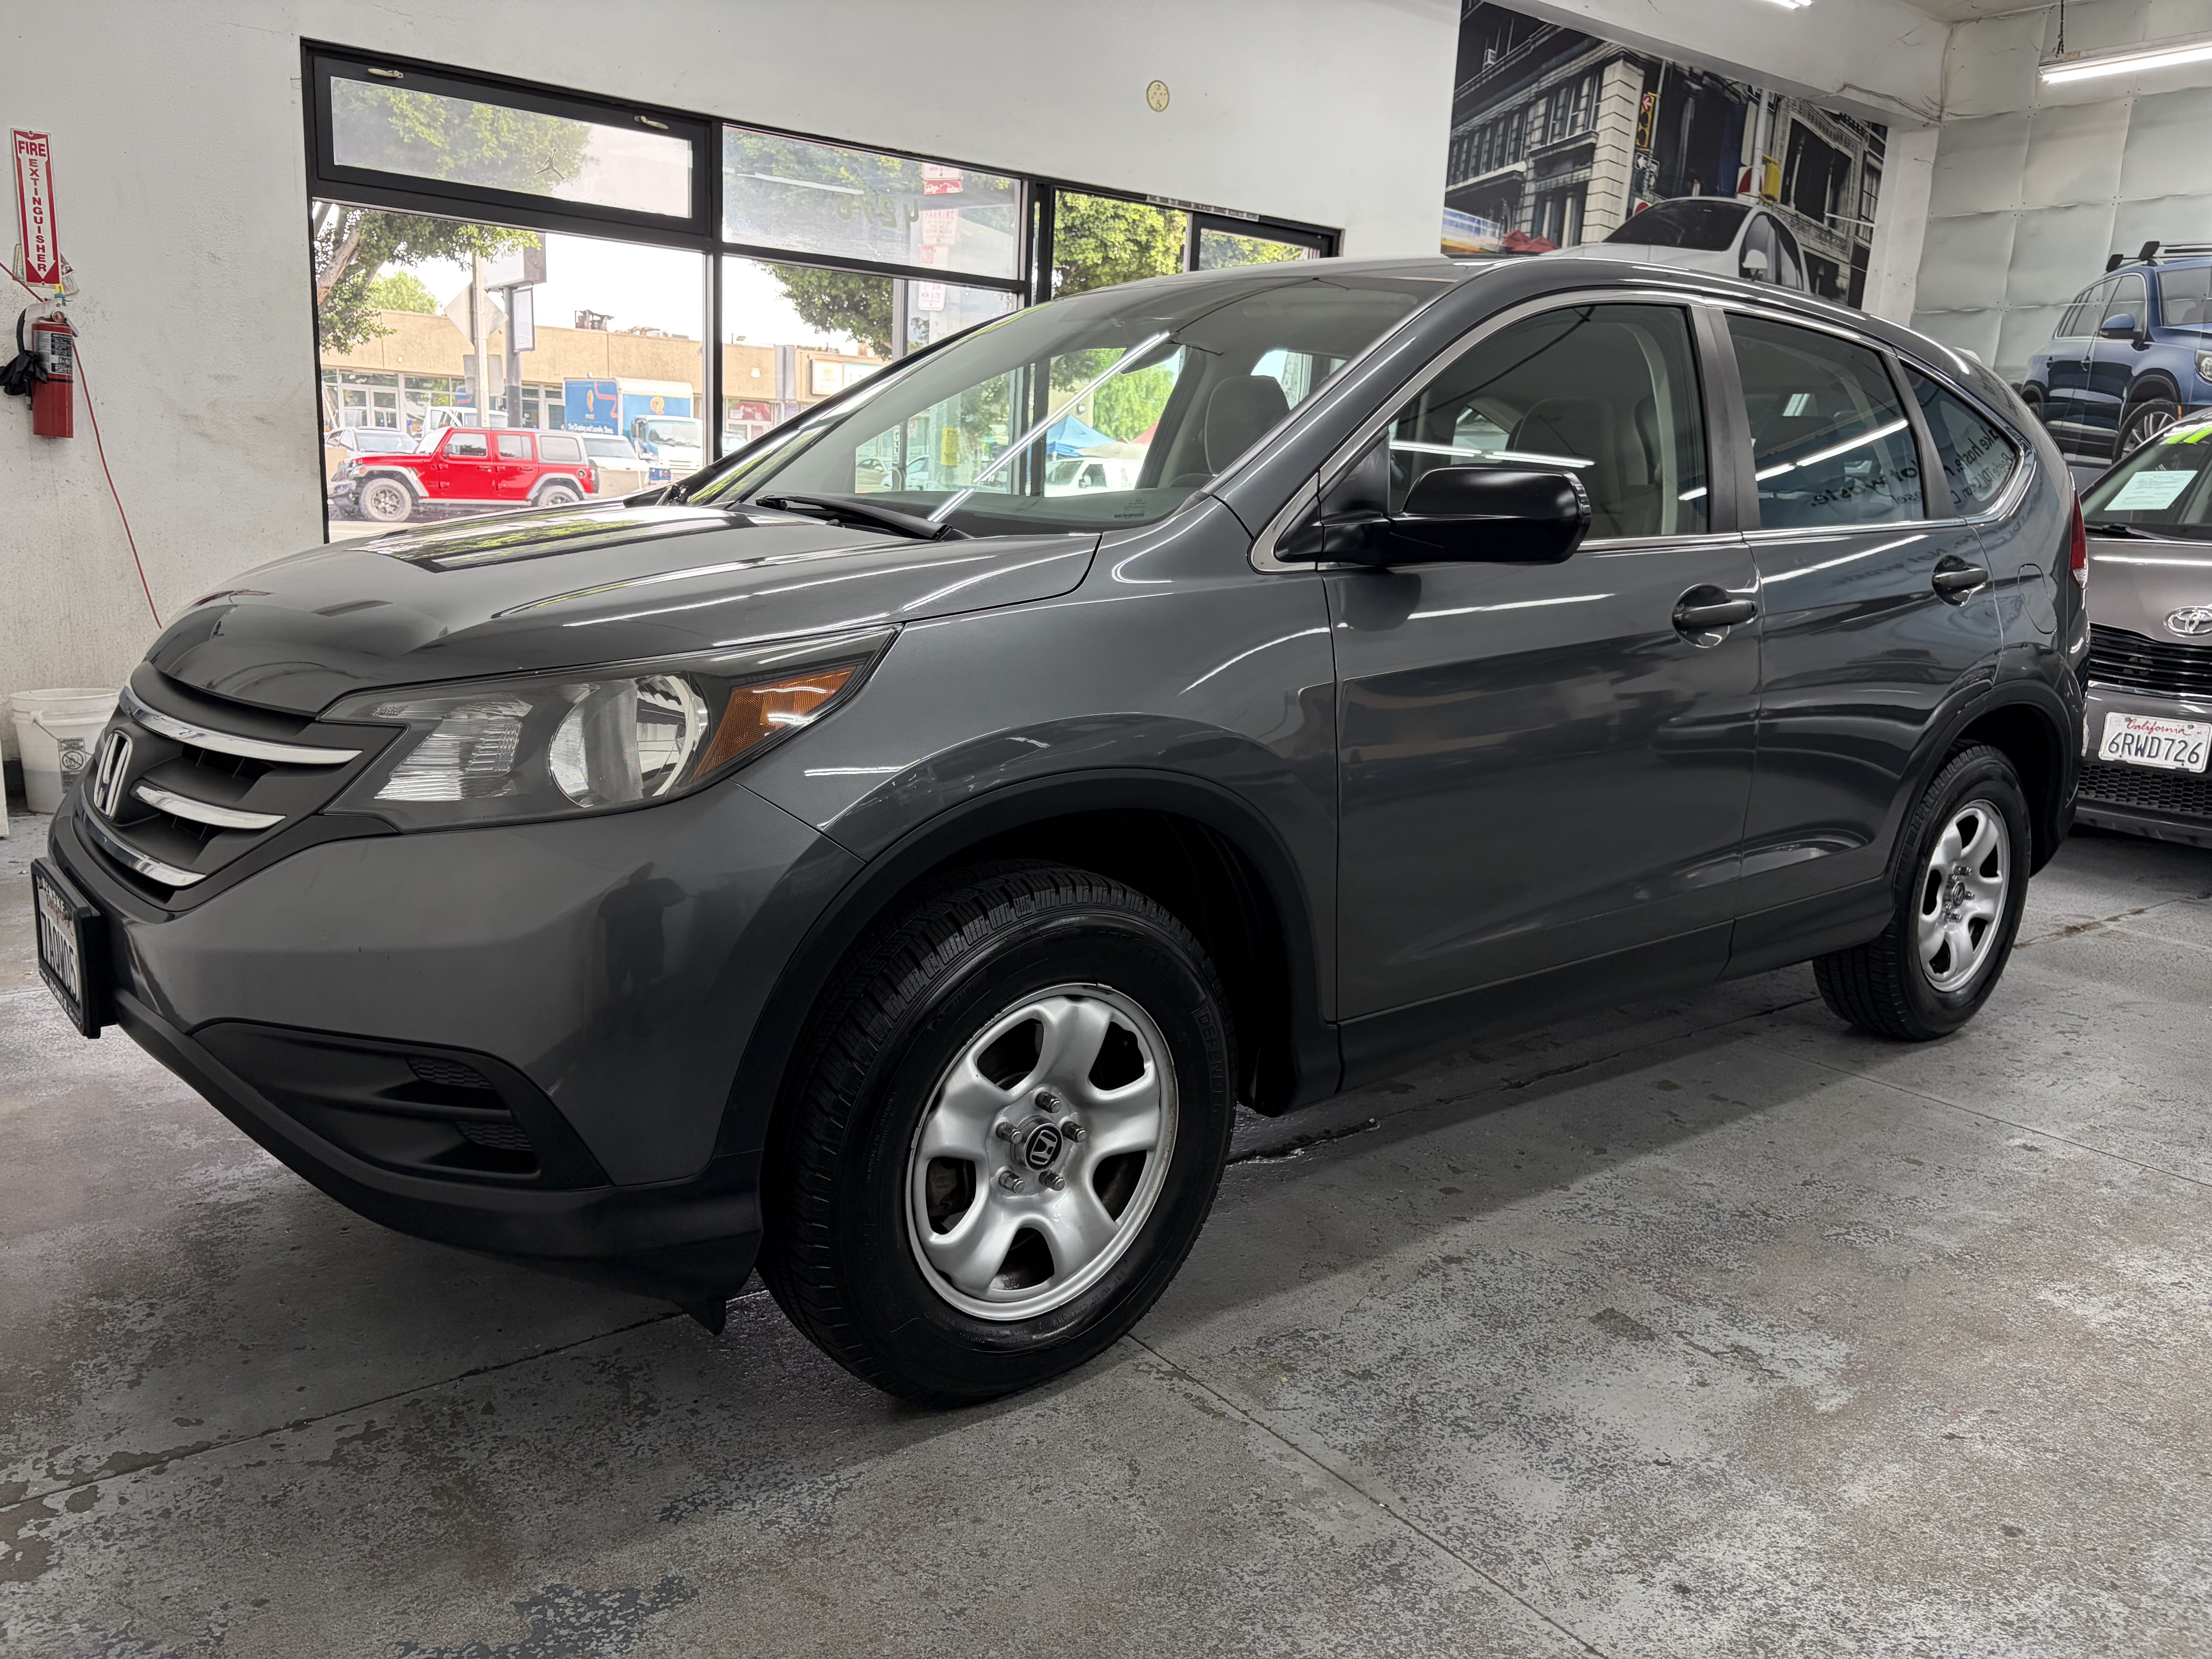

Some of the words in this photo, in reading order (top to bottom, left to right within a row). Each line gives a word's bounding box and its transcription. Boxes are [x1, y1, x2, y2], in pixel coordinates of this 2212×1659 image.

[18, 140, 46, 157] FIRE
[29, 158, 46, 271] EXTINGUISHER
[2126, 718, 2191, 736] California
[2108, 732, 2203, 764] 6RWD726
